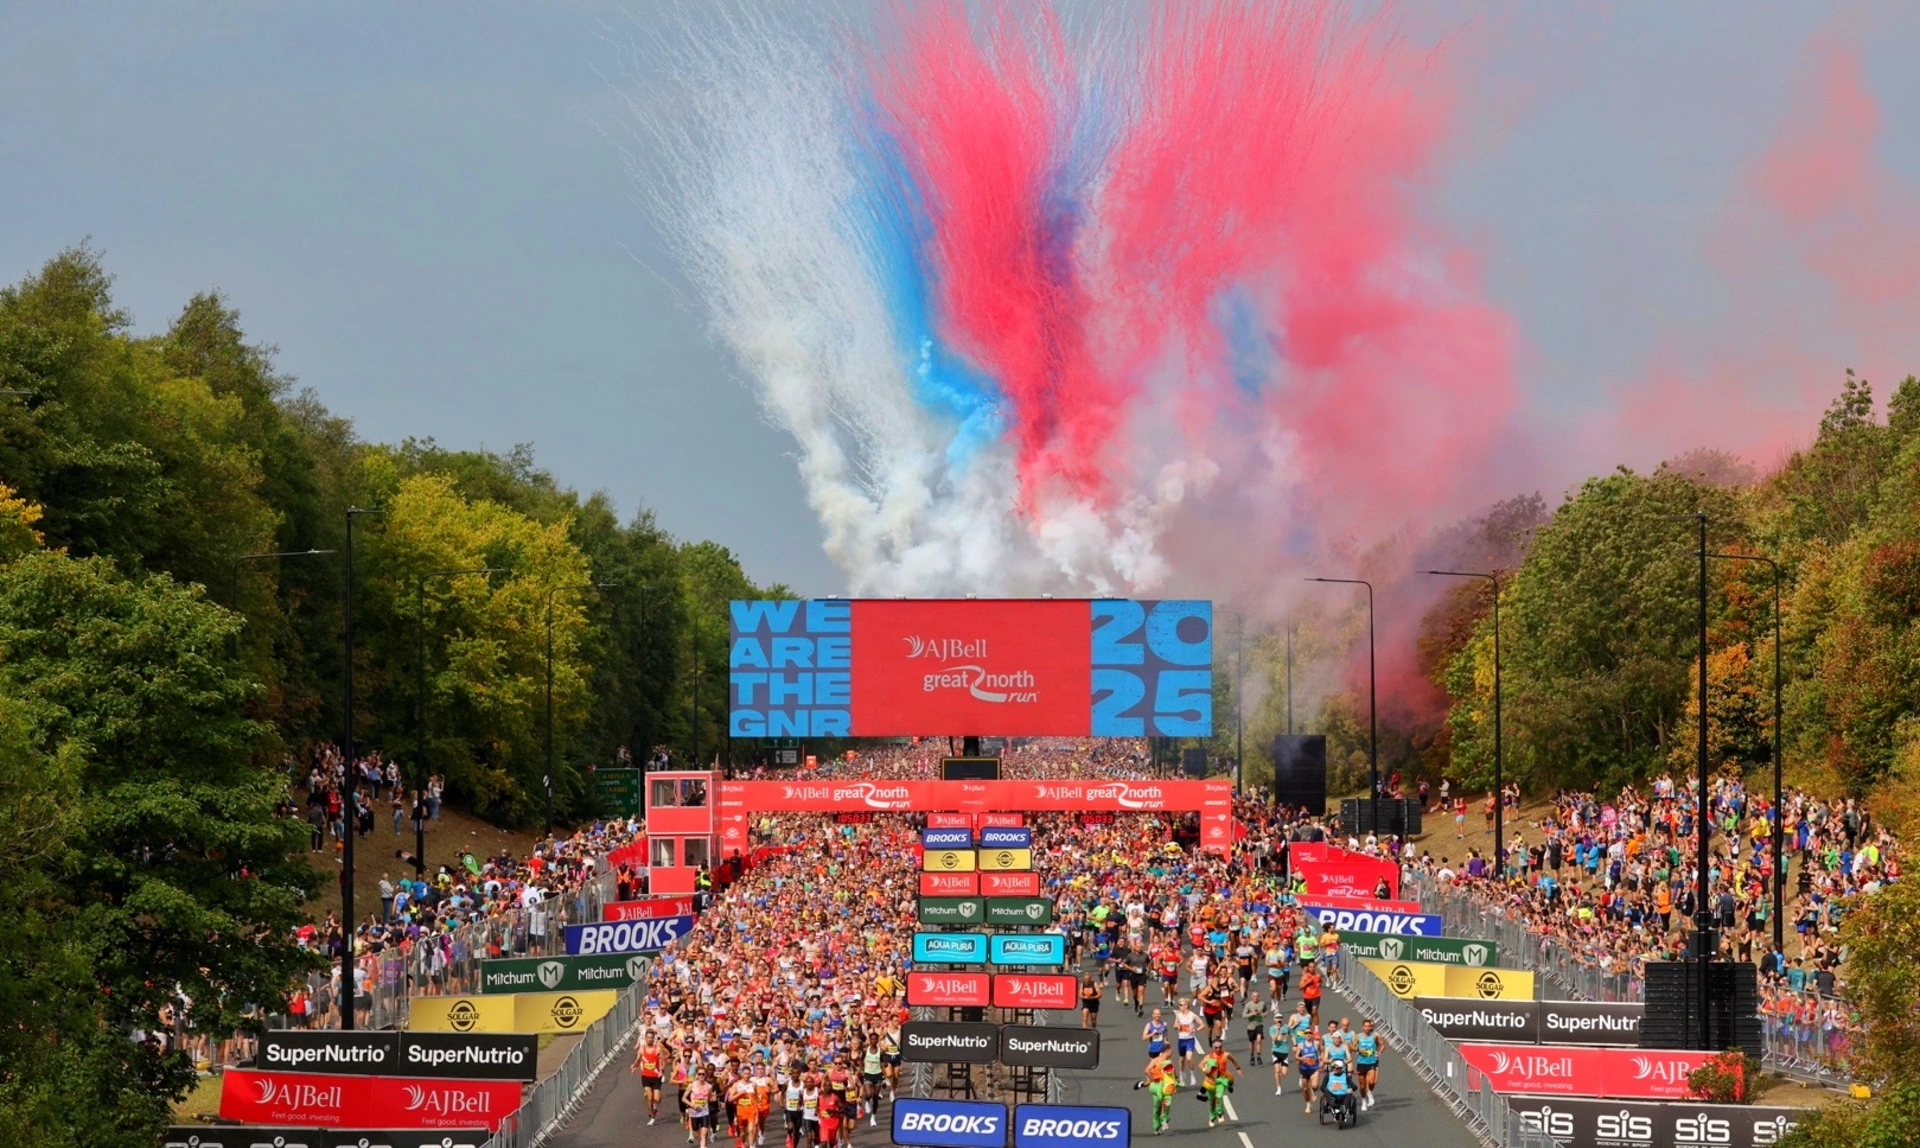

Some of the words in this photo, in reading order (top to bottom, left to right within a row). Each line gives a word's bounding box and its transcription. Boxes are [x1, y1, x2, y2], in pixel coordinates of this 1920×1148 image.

[730, 600, 850, 632] WE
[1091, 600, 1212, 665] 20
[730, 637, 850, 668] ARE
[923, 670, 969, 692] great
[986, 669, 1034, 688] north
[730, 672, 850, 705] THE
[1008, 691, 1038, 703] run
[1091, 669, 1212, 737] 25
[730, 709, 850, 737] GNR
[833, 788, 864, 801] great
[876, 787, 909, 798] north
[1086, 788, 1117, 800] great
[1129, 786, 1161, 798] north
[926, 833, 967, 843] BROOKS
[985, 832, 1026, 842] BROOKS
[924, 905, 955, 915] Mitchum
[992, 906, 1023, 916] Mitchum
[579, 919, 678, 954] BROOKS
[928, 940, 950, 949] AQUA
[1005, 940, 1027, 951] AQUA
[1417, 948, 1459, 962] Mitchum
[487, 971, 534, 985] Mitchum
[578, 967, 622, 981] Mitchum
[1388, 975, 1416, 985] SOLGAR
[934, 979, 977, 995] AJBell
[1021, 981, 1063, 997] AJBell
[1476, 982, 1504, 991] SOLGAR
[447, 1012, 479, 1021] SOLGAR
[551, 1008, 583, 1017] SOLGAR
[1547, 1013, 1640, 1033] SuperNutri
[1509, 1056, 1573, 1079] AJBell
[1508, 1079, 1521, 1087] Feel
[274, 1084, 342, 1110] AJBell
[424, 1090, 490, 1116] AJBell
[271, 1111, 286, 1119] Feel
[422, 1117, 436, 1125] Feel
